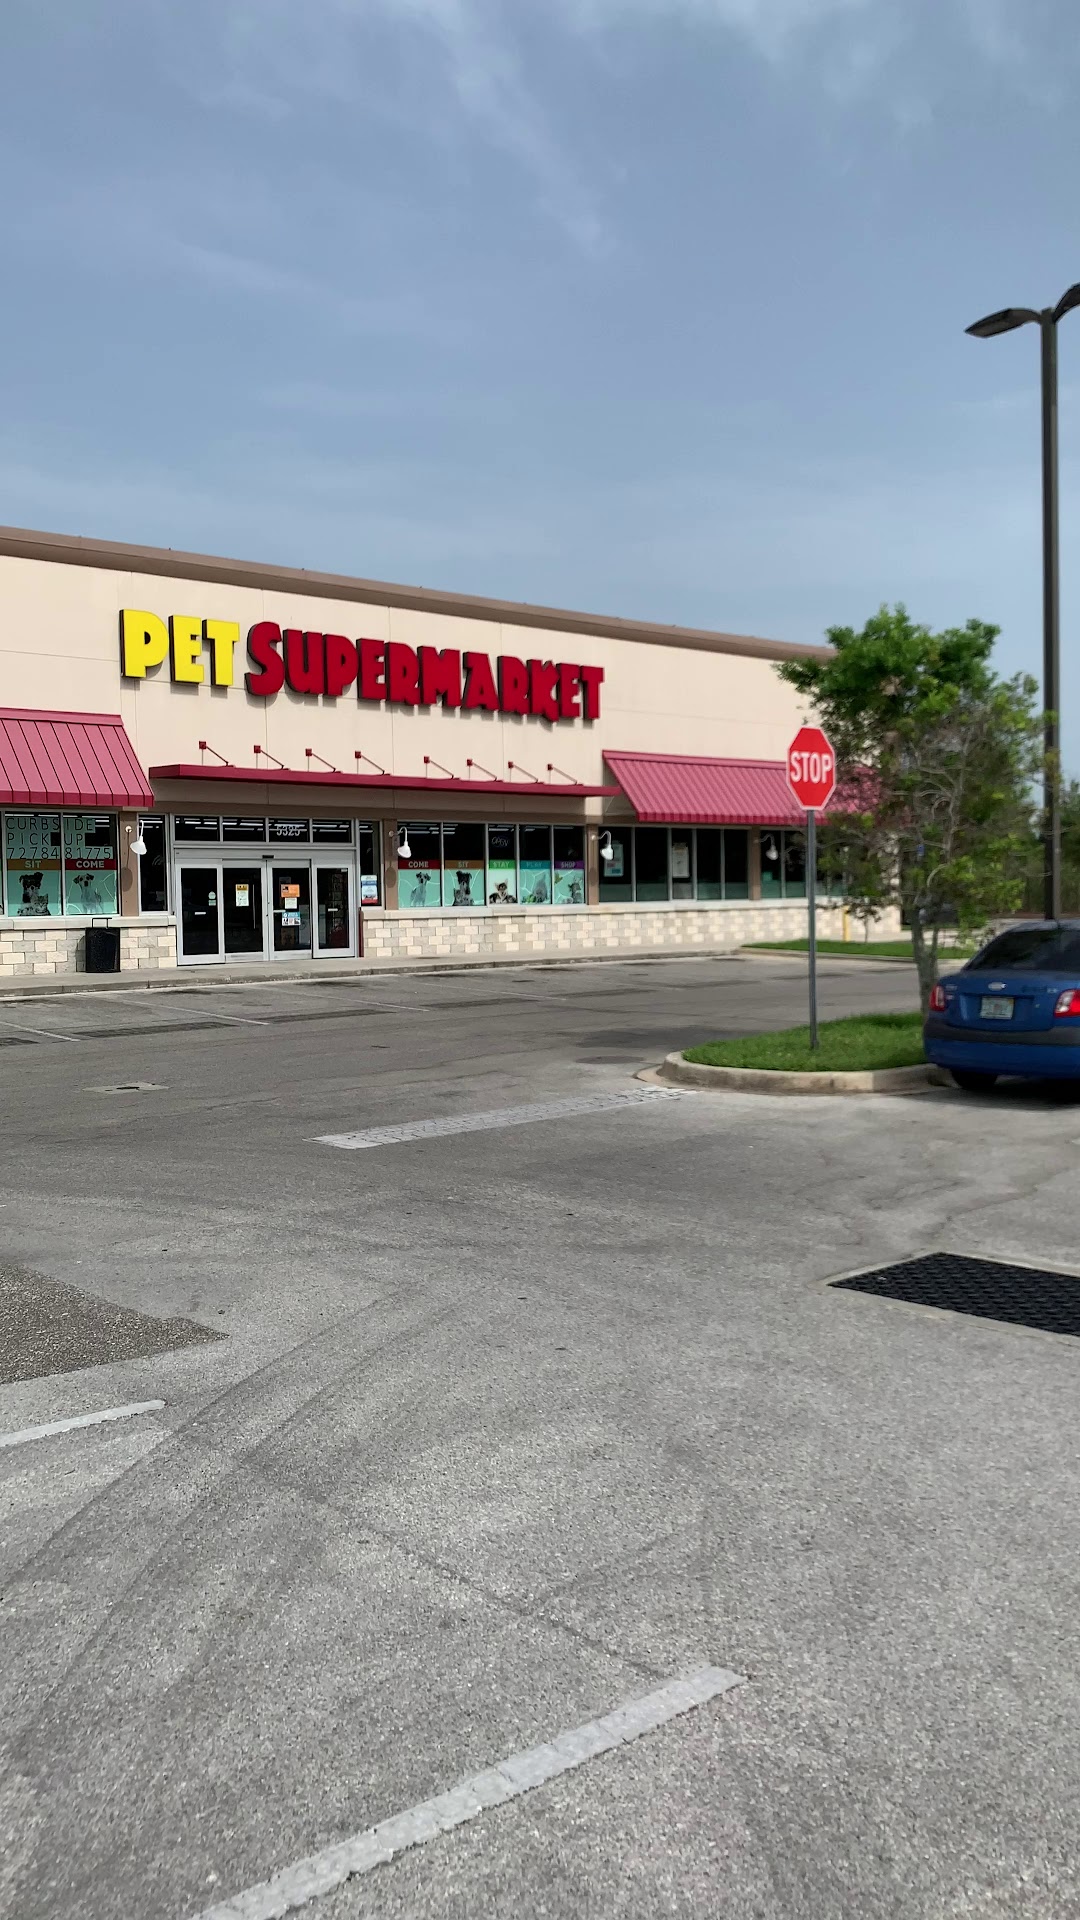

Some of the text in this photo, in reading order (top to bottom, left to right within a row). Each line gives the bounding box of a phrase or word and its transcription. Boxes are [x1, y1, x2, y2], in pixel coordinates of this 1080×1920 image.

[119, 609, 604, 722] PET SUPERMARKET
[790, 750, 832, 784] STOP
[5, 817, 94, 831] CURBSIDE
[7, 832, 84, 846] PICK UP
[24, 860, 42, 869] SIT
[75, 860, 105, 869] COME
